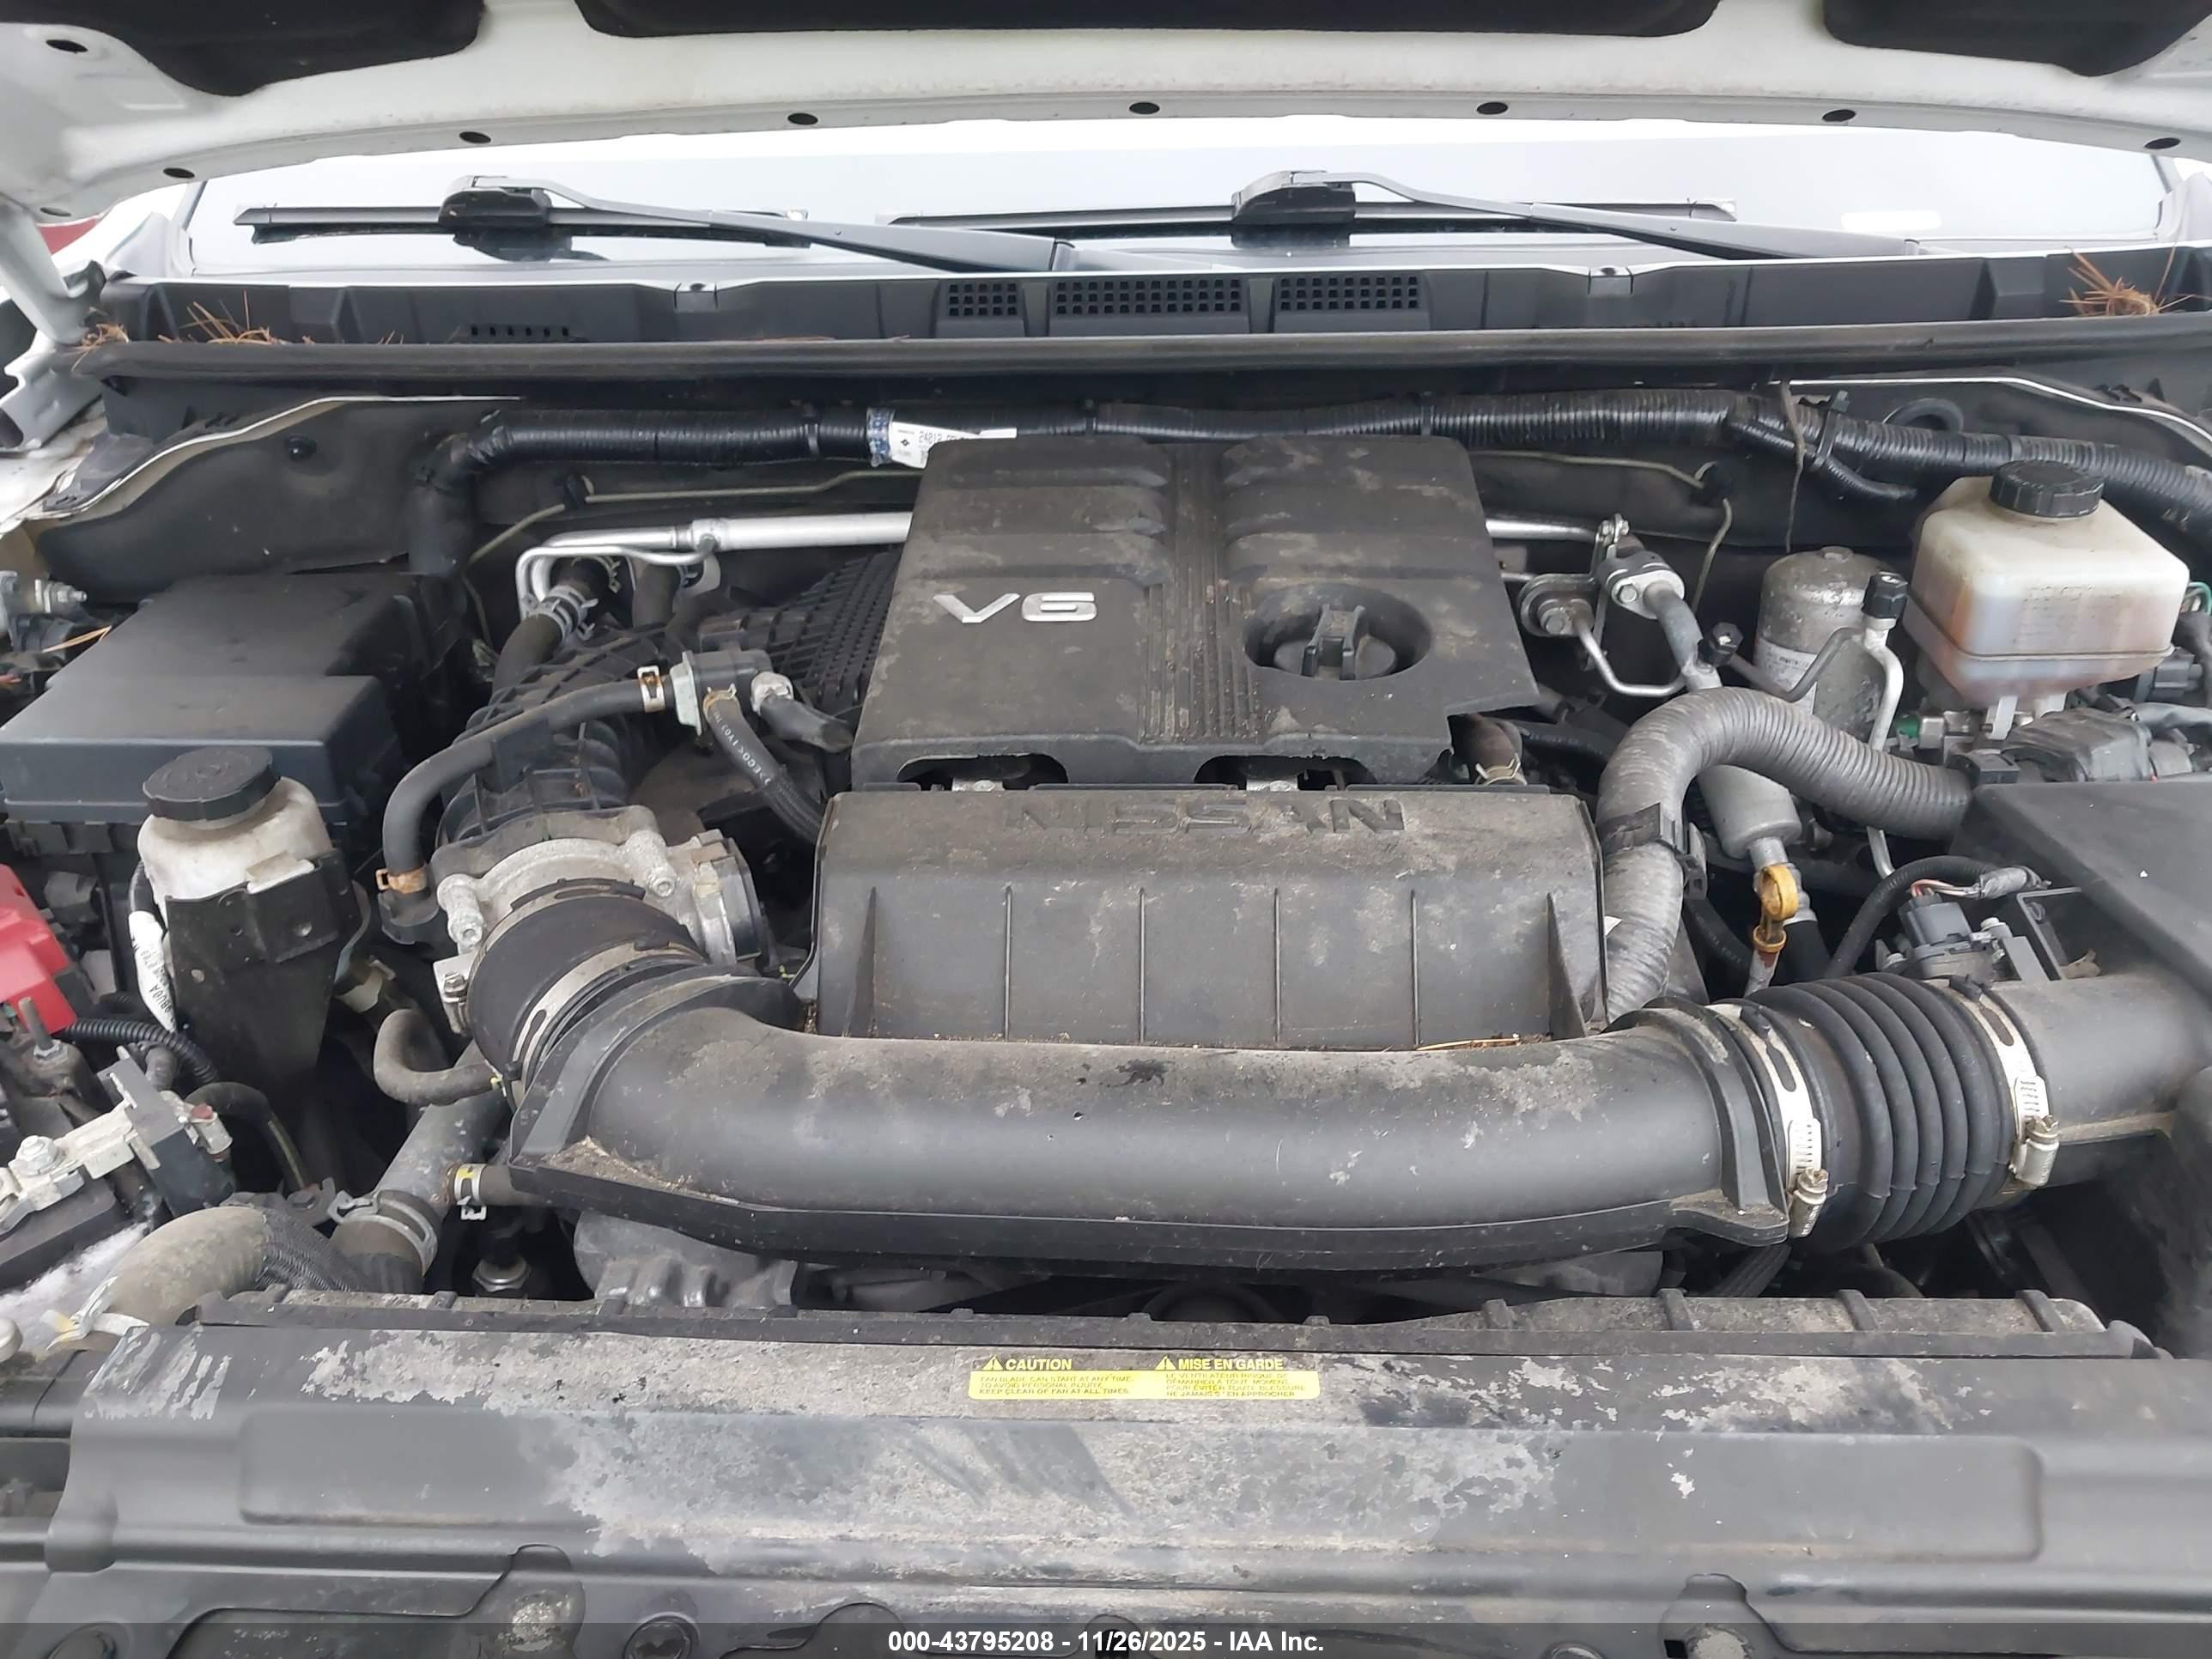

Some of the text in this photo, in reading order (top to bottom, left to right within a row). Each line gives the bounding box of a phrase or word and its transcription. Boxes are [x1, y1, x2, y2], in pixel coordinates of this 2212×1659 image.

[933, 592, 1097, 623] V6
[1003, 798, 1406, 834] NISSAN
[1006, 1358, 1073, 1370] CAUTION
[1178, 1358, 1285, 1370] MISE EN GARDE
